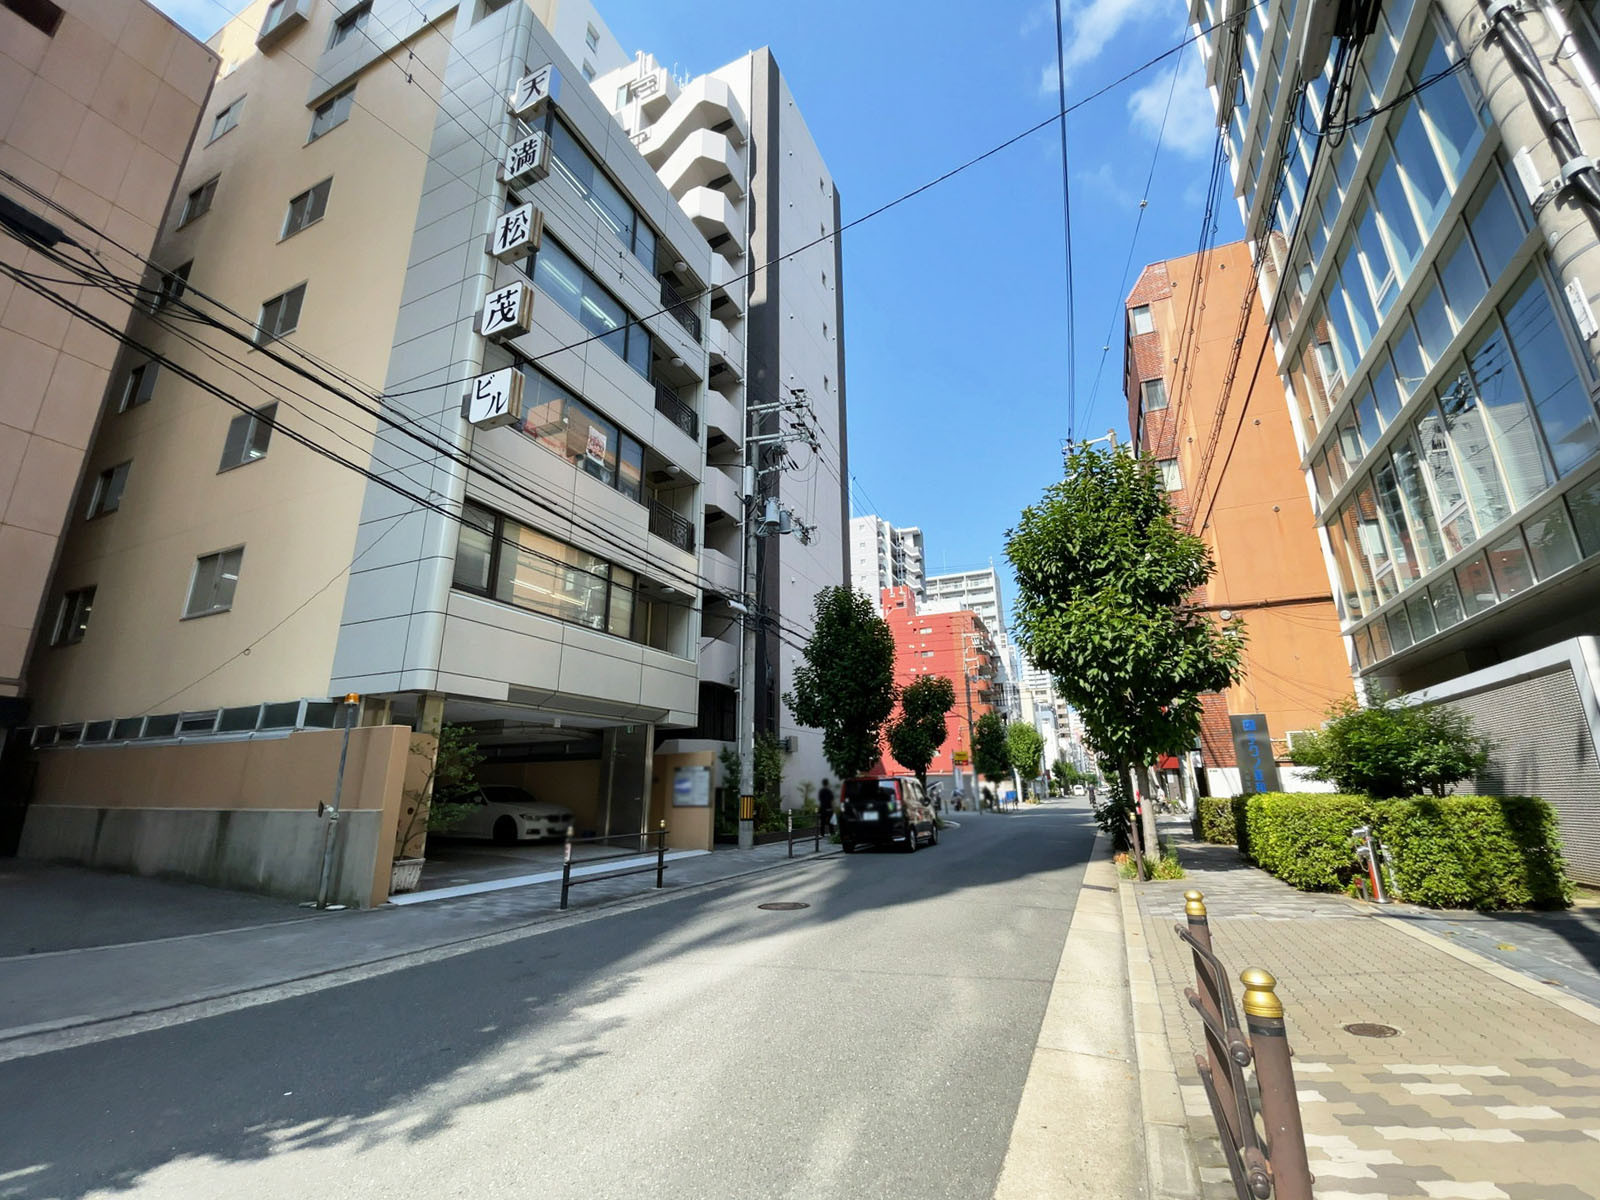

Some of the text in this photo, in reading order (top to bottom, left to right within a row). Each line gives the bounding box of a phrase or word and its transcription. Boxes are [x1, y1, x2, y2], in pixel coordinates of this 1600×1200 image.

[476, 69, 548, 418] 天満松茂ビル
